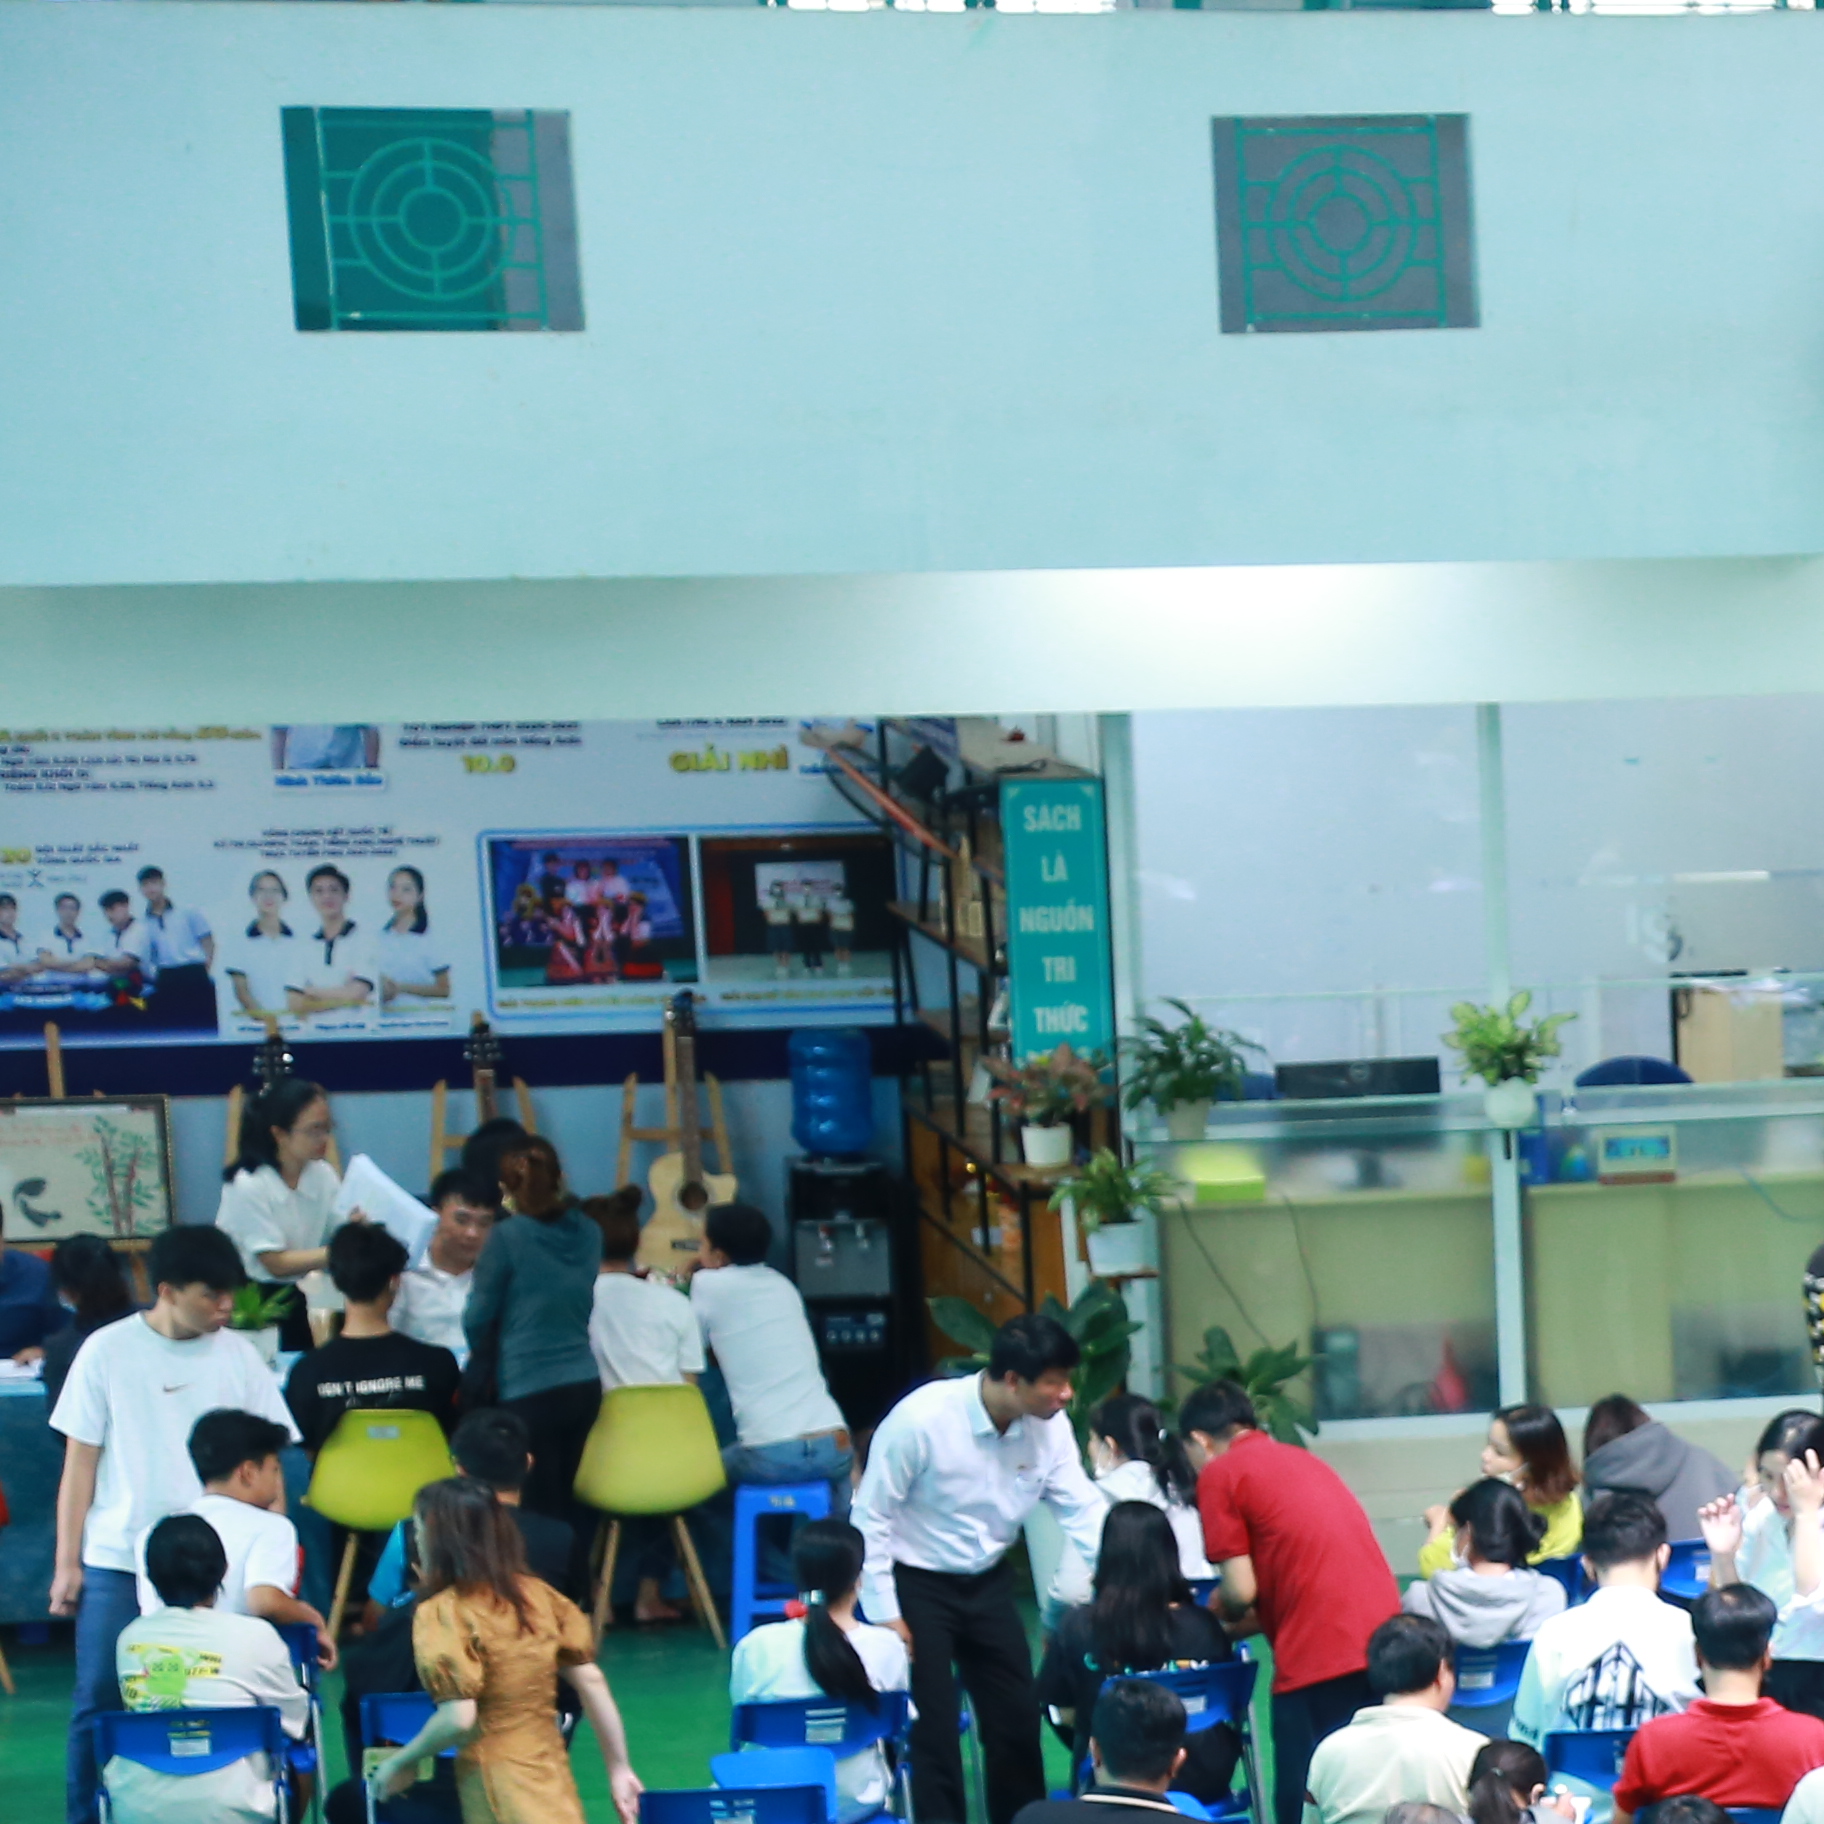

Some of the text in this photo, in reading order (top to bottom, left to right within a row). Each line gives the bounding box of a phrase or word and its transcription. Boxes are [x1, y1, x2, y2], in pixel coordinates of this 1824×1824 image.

[669, 743, 730, 772] GIẢI
[1023, 803, 1082, 832] SÁCH
[1041, 849, 1068, 882] LÀ
[1042, 956, 1076, 982] TRI
[1034, 1000, 1089, 1034] THỨC
[356, 1376, 402, 1394] IGNORE
[405, 1375, 424, 1391] ME
